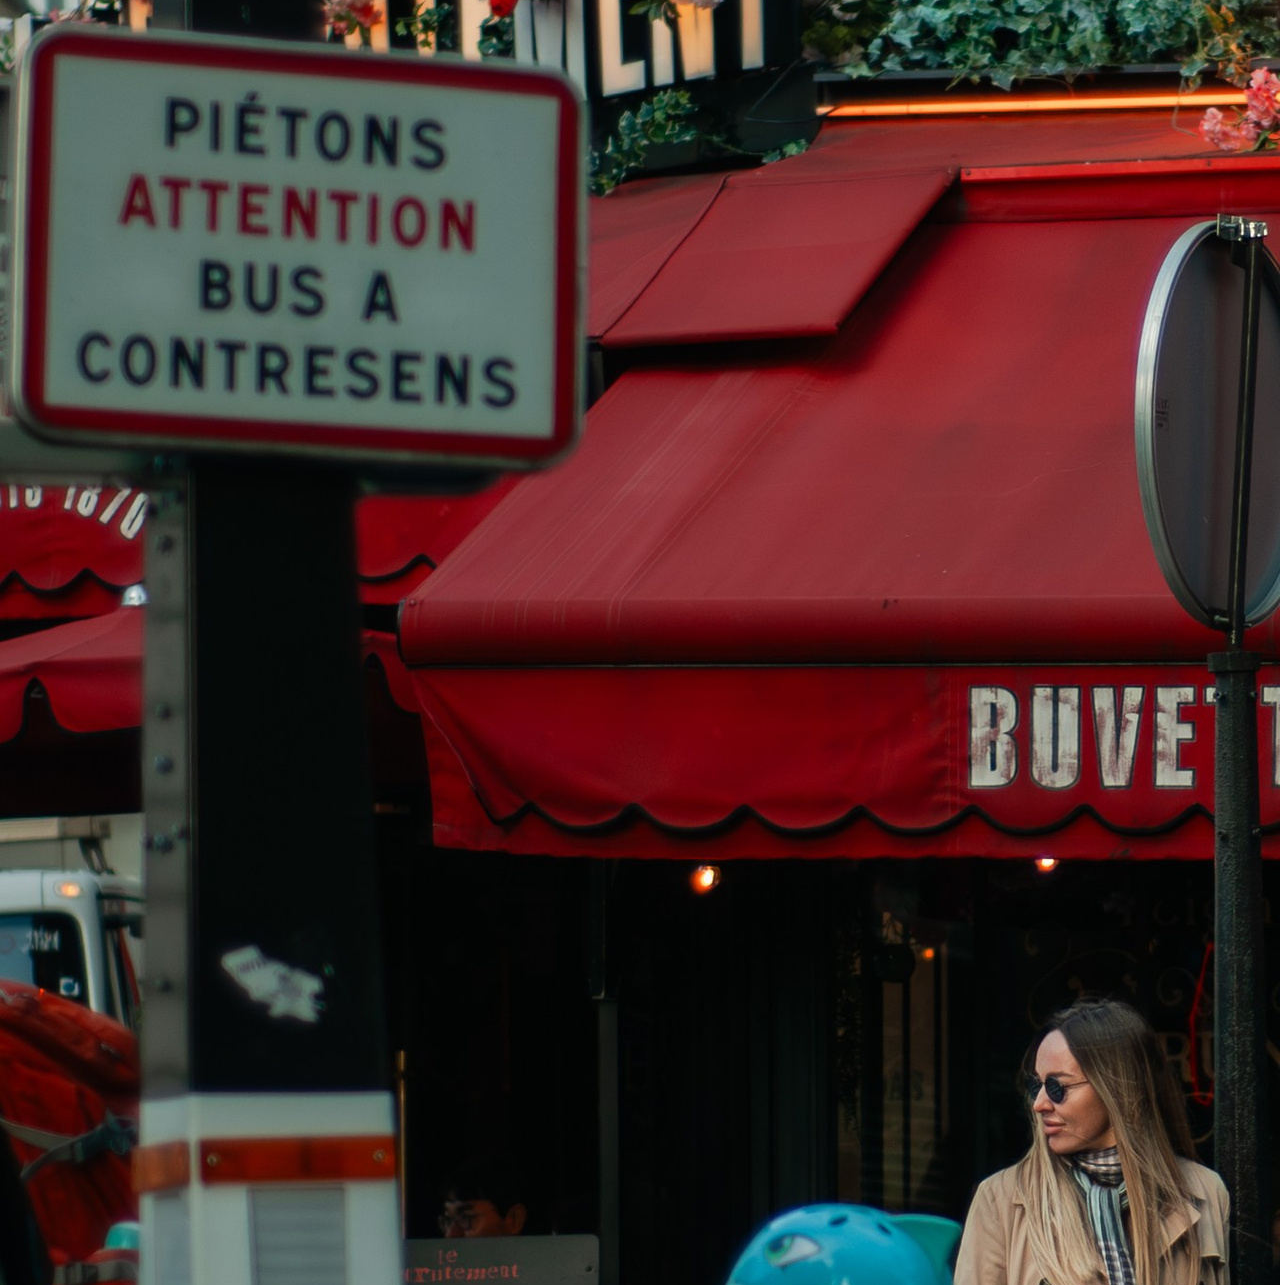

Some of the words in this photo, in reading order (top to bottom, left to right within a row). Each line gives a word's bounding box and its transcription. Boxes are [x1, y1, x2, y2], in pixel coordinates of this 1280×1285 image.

[165, 93, 448, 171] PIÉTONS
[118, 173, 476, 252] ATTENTION
[200, 260, 325, 316] BUS
[363, 271, 399, 323] A
[76, 332, 517, 409] CONTRESENS
